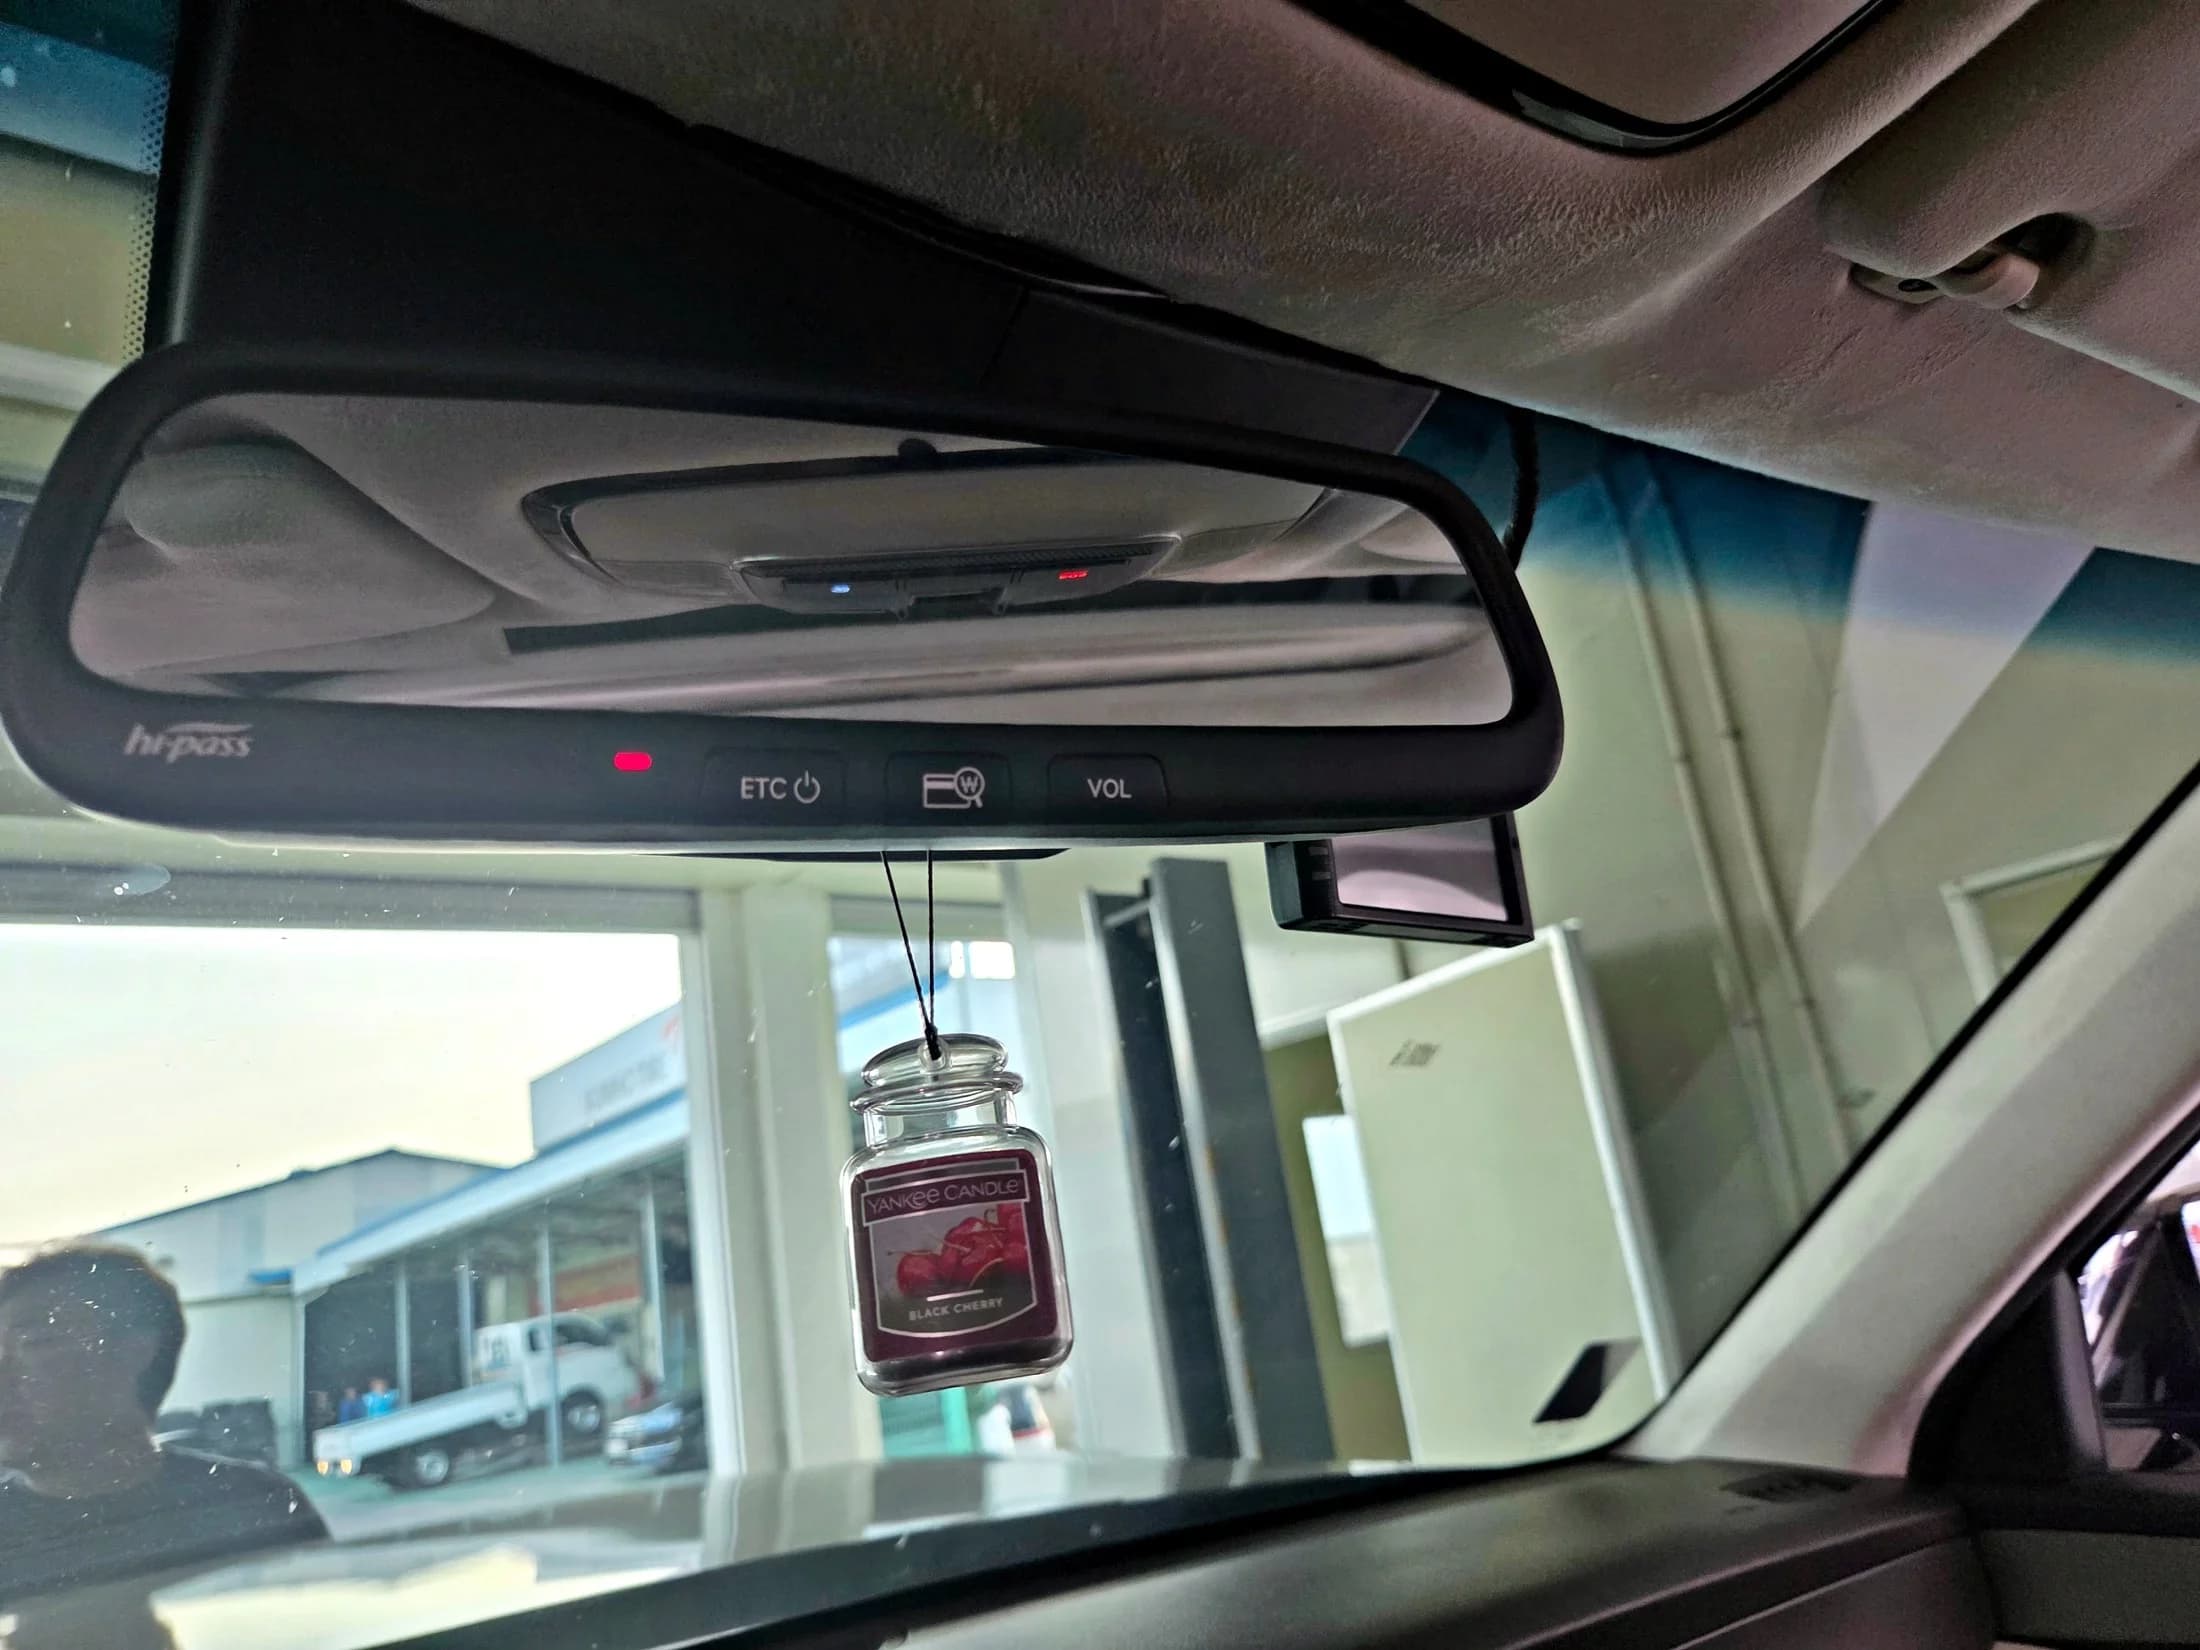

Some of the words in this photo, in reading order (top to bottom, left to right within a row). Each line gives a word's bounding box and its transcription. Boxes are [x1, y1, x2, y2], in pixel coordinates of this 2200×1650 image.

[741, 776, 788, 800] ETC
[1087, 778, 1132, 799] VOL
[909, 1304, 950, 1321] BLACK
[953, 1297, 1004, 1314] CHERRY
